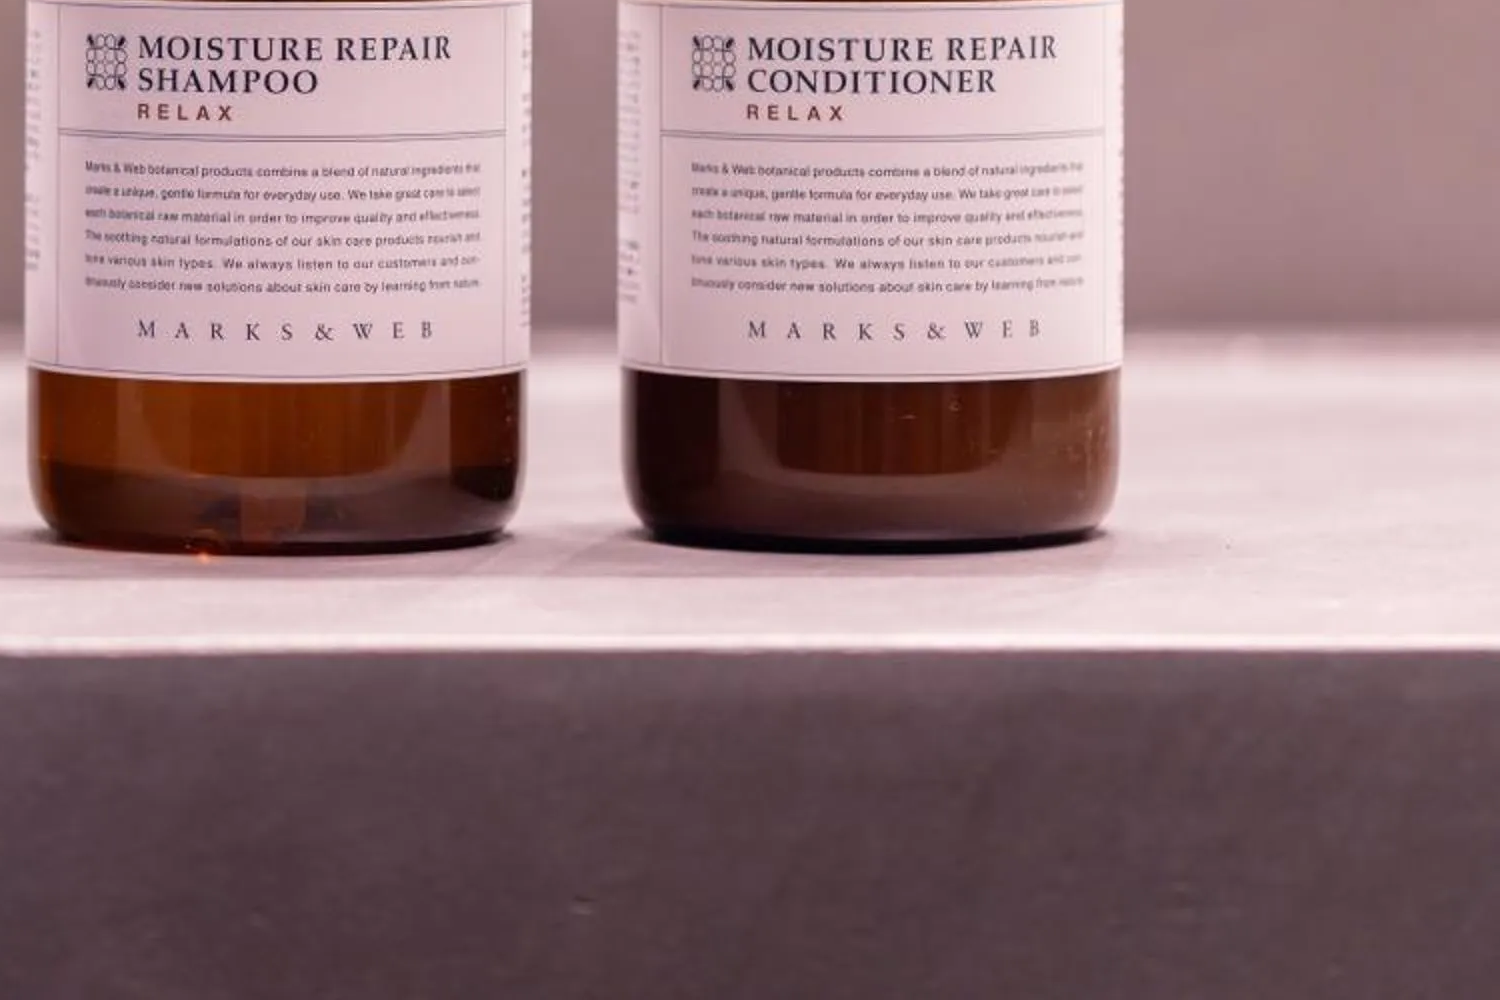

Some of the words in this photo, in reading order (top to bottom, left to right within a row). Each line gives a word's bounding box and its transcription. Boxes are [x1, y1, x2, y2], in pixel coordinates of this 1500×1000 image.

[137, 35, 323, 61] MOISTURE
[336, 35, 451, 61] REPAIR
[748, 37, 933, 62] MOISTURE
[947, 35, 1057, 61] REPAIR
[138, 69, 318, 95] SHAMPOO
[748, 69, 996, 94] CONDITIONER
[137, 104, 233, 121] RELAX
[747, 104, 845, 121] RELAX
